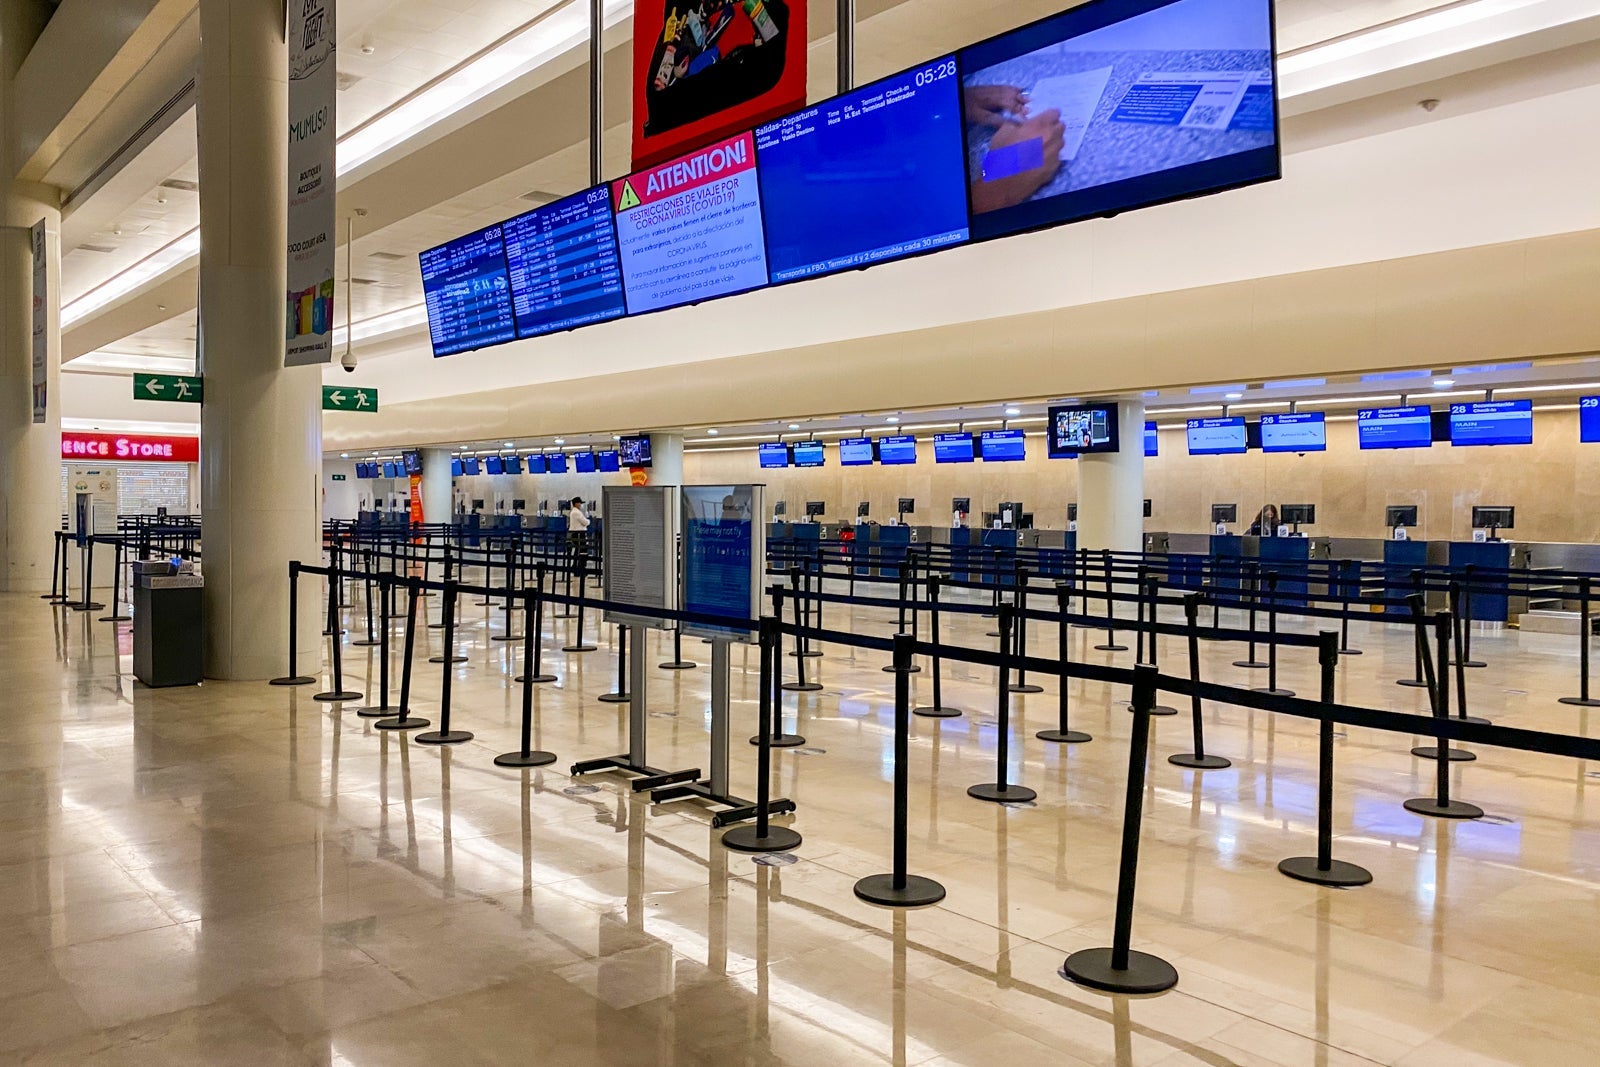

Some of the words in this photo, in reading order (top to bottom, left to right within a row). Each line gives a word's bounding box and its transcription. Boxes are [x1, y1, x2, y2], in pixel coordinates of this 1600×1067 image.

[915, 59, 955, 88] 05:28
[828, 116, 840, 126] Hora
[862, 99, 885, 114] Terminal
[886, 88, 915, 105] Mostrador
[861, 93, 883, 106] Terminal
[644, 139, 746, 196] ATTENTION!
[587, 188, 608, 204] 05:28
[629, 195, 683, 222] RESTRICCIONES
[685, 192, 695, 204] DE
[697, 184, 720, 200] VIAJE
[720, 177, 739, 192] POR
[635, 205, 690, 230] CORONAVIRUS
[691, 190, 735, 214] (COVID19)
[683, 216, 699, 226] tienen
[732, 198, 756, 212] fronteras
[484, 227, 501, 241] 05:28
[632, 247, 643, 256] para
[828, 256, 852, 269] Terminal
[859, 254, 864, 262] y
[870, 243, 902, 260] disponible
[903, 240, 920, 251] cada
[922, 237, 931, 246] 30
[932, 230, 960, 244] minutos
[1452, 406, 1466, 414] 28
[1582, 398, 1598, 408] 29
[1359, 411, 1372, 419] 27
[62, 440, 108, 455] ENCE
